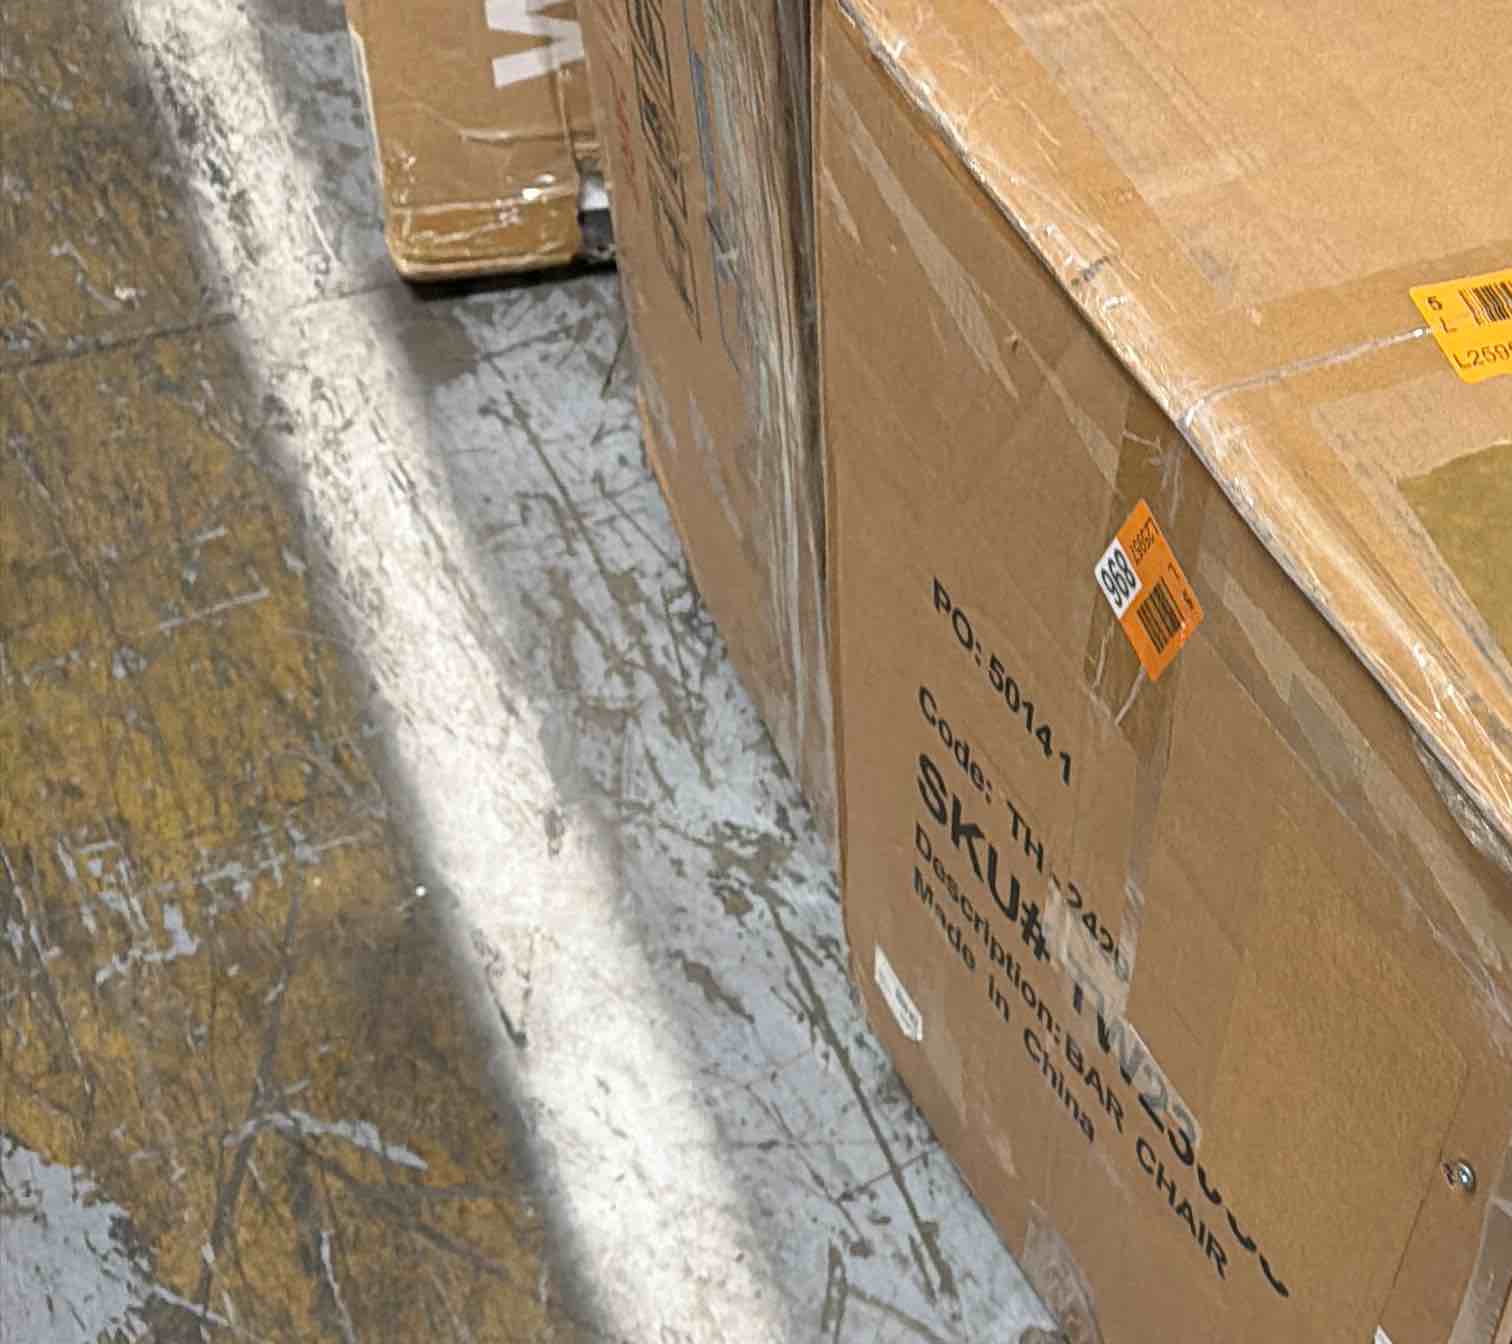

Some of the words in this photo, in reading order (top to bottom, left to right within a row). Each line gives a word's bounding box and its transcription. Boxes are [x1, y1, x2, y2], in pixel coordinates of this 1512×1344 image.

[932, 576, 985, 667] PO:
[987, 654, 1072, 786] 50141
[1100, 547, 1136, 609] 896
[918, 685, 993, 803] Code:
[917, 753, 1052, 962] SKU#
[912, 865, 978, 973] Made
[1023, 1026, 1097, 1145] China
[914, 821, 1062, 1045] Description:
[1064, 1035, 1125, 1134] BAR
[1136, 1135, 1228, 1281] CHAIR
